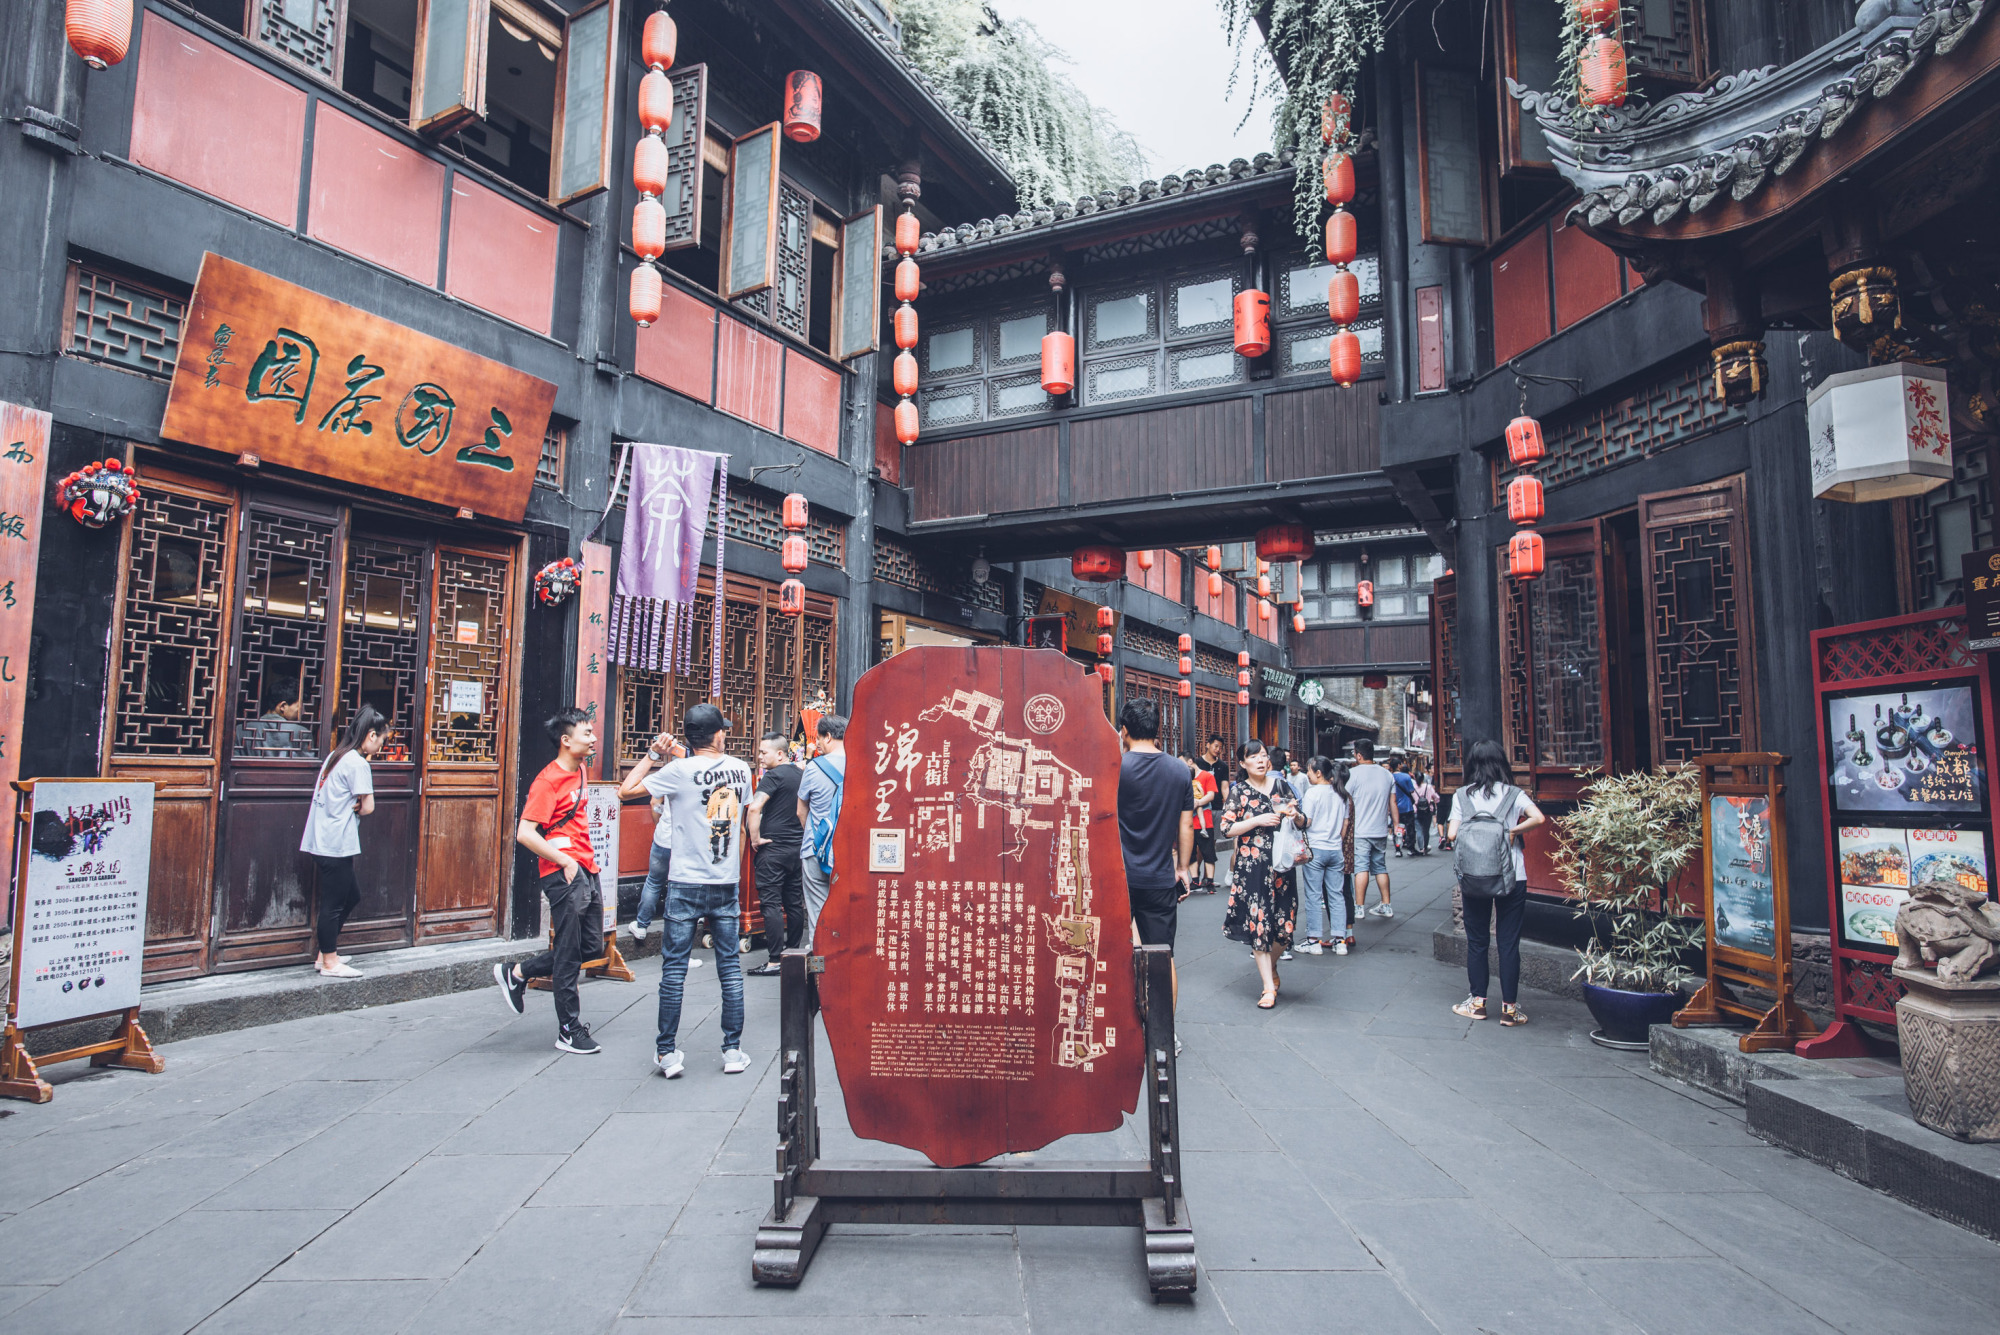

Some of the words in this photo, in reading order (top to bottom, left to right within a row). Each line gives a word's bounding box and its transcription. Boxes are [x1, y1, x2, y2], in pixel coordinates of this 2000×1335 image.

[1262, 666, 1296, 688] STARBUCKS
[1266, 686, 1286, 700] COFFEE
[925, 752, 942, 786] 古街
[1937, 757, 1970, 777] 成都
[694, 770, 746, 785] COMING
[1920, 775, 1972, 788] 传统小吃
[701, 787, 742, 805] SN
[1909, 788, 1974, 802] 套餐48元/位
